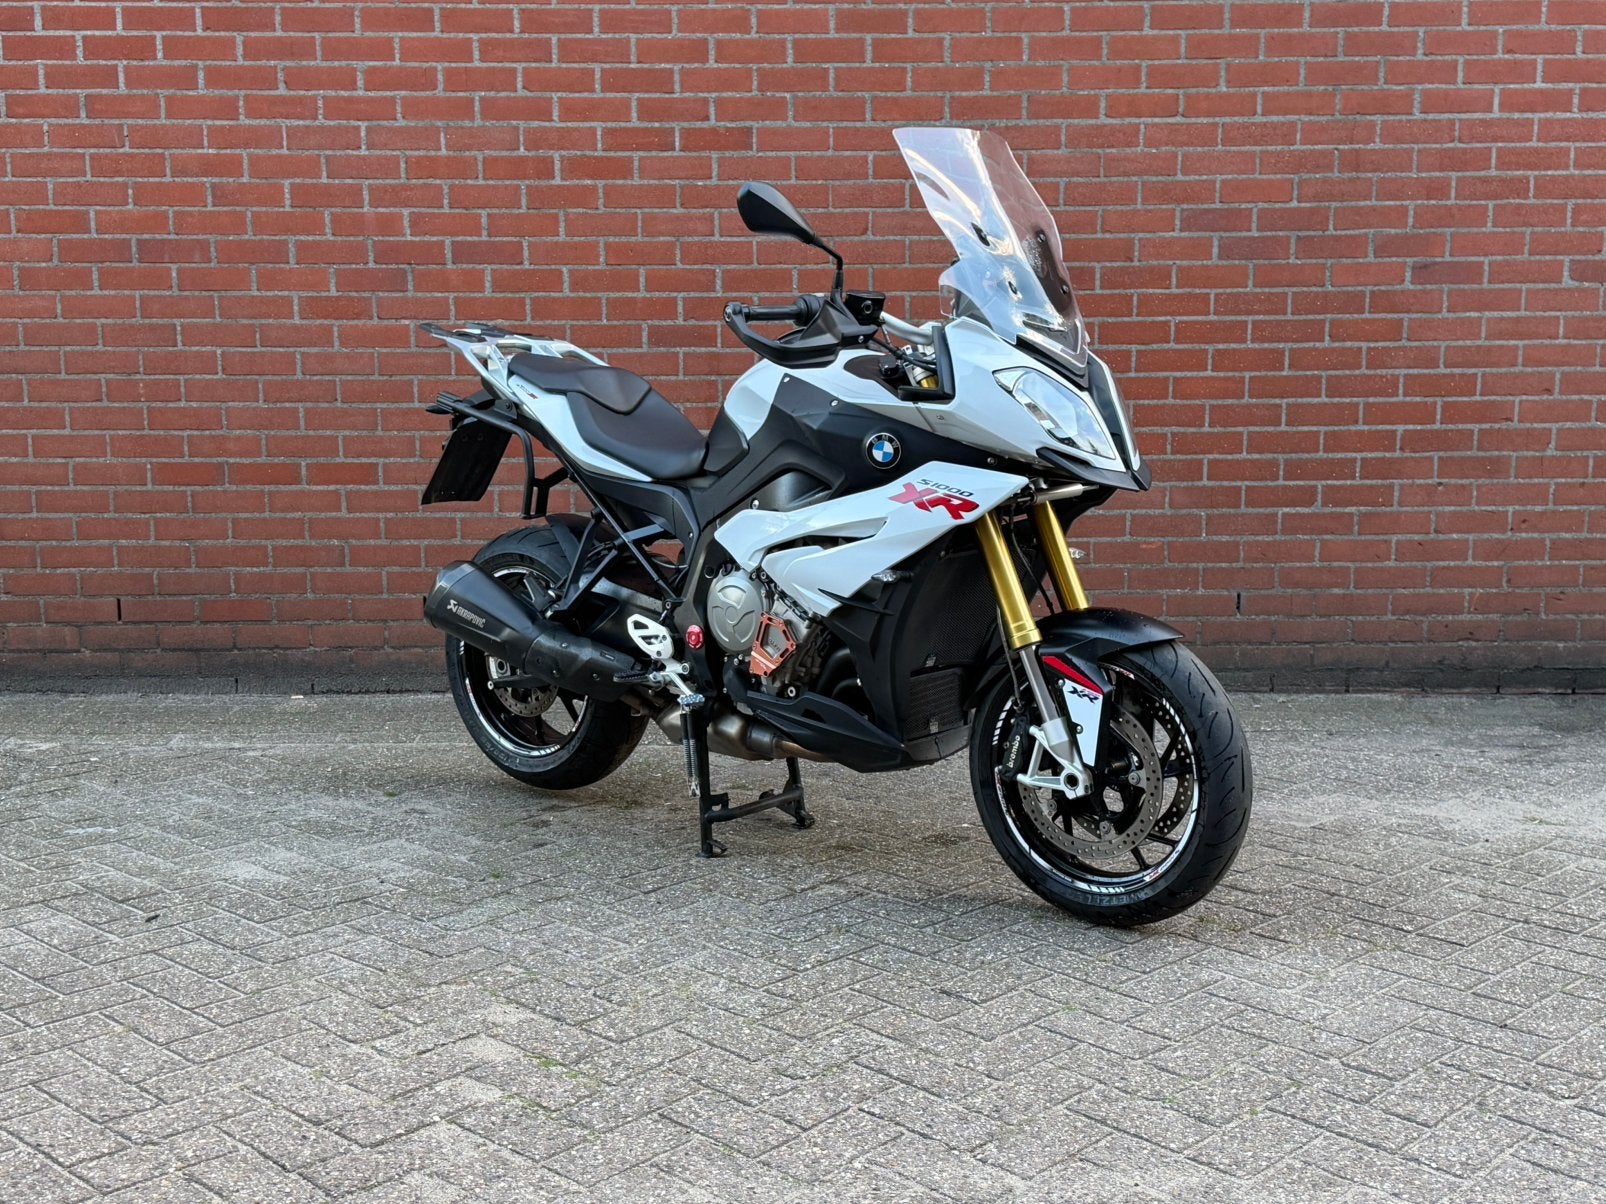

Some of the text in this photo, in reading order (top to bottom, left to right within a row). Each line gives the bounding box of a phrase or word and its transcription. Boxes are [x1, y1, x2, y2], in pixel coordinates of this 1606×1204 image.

[871, 434, 899, 448] BMW
[917, 479, 974, 497] S1000
[889, 482, 979, 520] XR
[1067, 685, 1100, 704] XR
[1006, 735, 1021, 768] brembo
